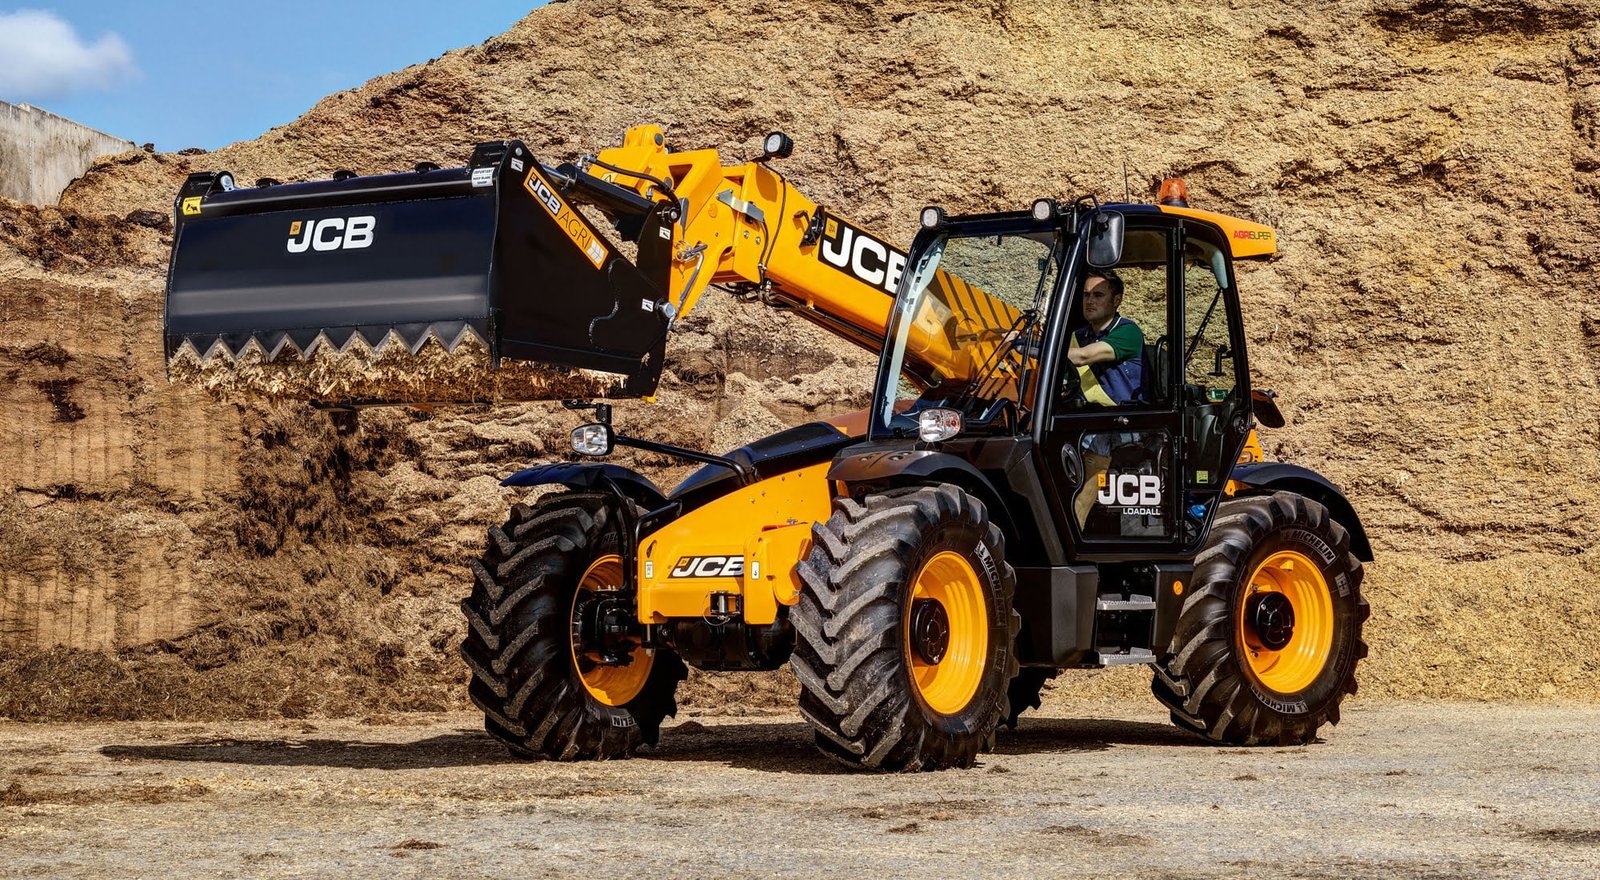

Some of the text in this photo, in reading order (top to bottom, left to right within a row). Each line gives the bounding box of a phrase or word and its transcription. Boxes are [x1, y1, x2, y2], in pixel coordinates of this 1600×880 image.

[528, 180, 592, 249] JCB AGRI
[287, 216, 376, 253] JCB
[1234, 230, 1272, 240] AGRISUPER
[1098, 474, 1161, 506] JCB
[1123, 507, 1160, 516] LOADALL
[1292, 530, 1335, 559] MICHELIN
[672, 557, 744, 577] JCB
[1252, 686, 1296, 713] MICHELIN
[613, 715, 635, 727] ELIN
